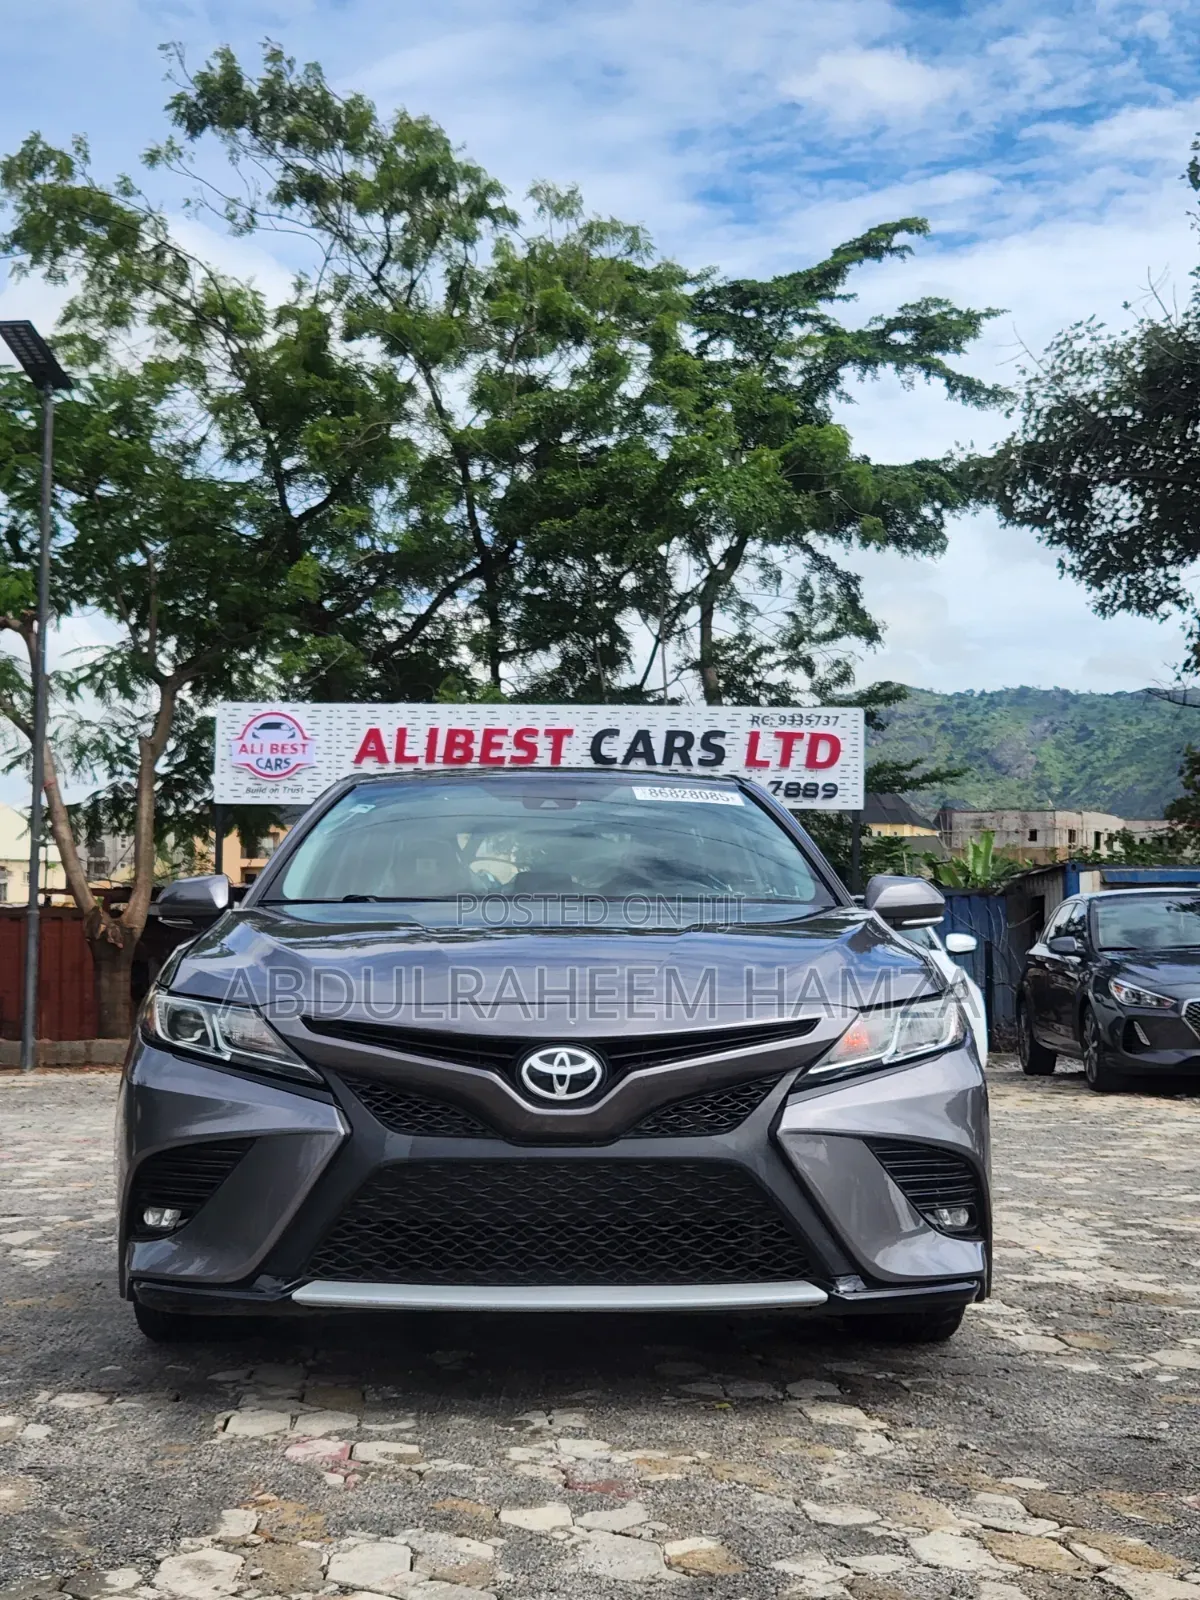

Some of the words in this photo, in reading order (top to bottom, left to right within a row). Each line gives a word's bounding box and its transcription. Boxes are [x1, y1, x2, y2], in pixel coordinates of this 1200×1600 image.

[778, 714, 840, 727] 9335737
[238, 743, 264, 755] ALI
[269, 743, 309, 755] BEST
[353, 727, 574, 766] ALIBEST
[590, 728, 727, 767] CARS
[744, 731, 842, 770] LTD
[255, 757, 292, 771] CARS
[245, 786, 267, 794] Build
[283, 786, 305, 794] Trust
[767, 780, 839, 800] 7889
